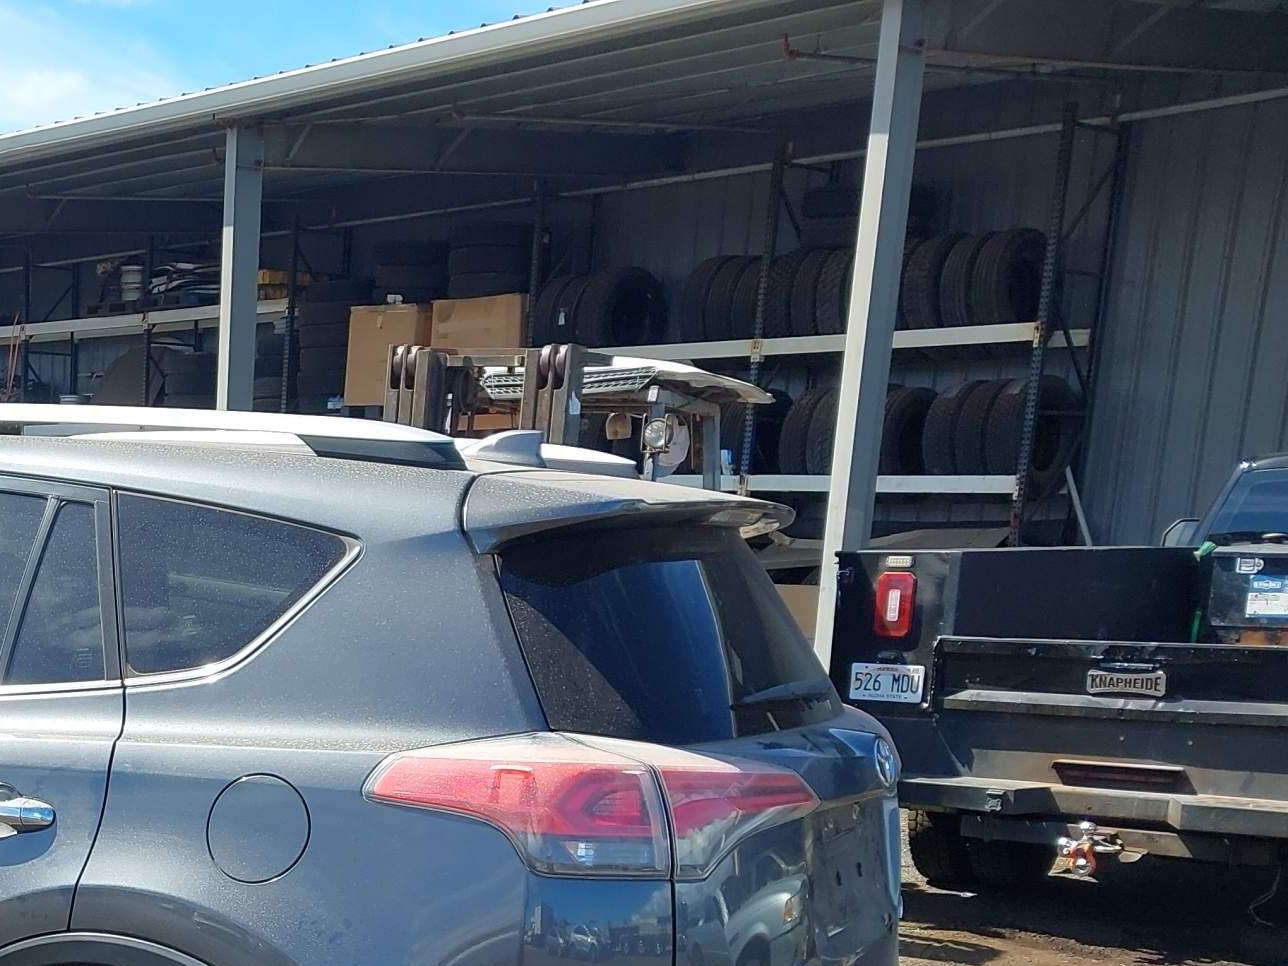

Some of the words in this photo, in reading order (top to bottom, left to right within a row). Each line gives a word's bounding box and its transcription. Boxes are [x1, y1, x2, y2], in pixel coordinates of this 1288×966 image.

[854, 671, 882, 692] 526
[890, 673, 921, 694] MDU
[1089, 674, 1161, 692] KNAPHEIDE
